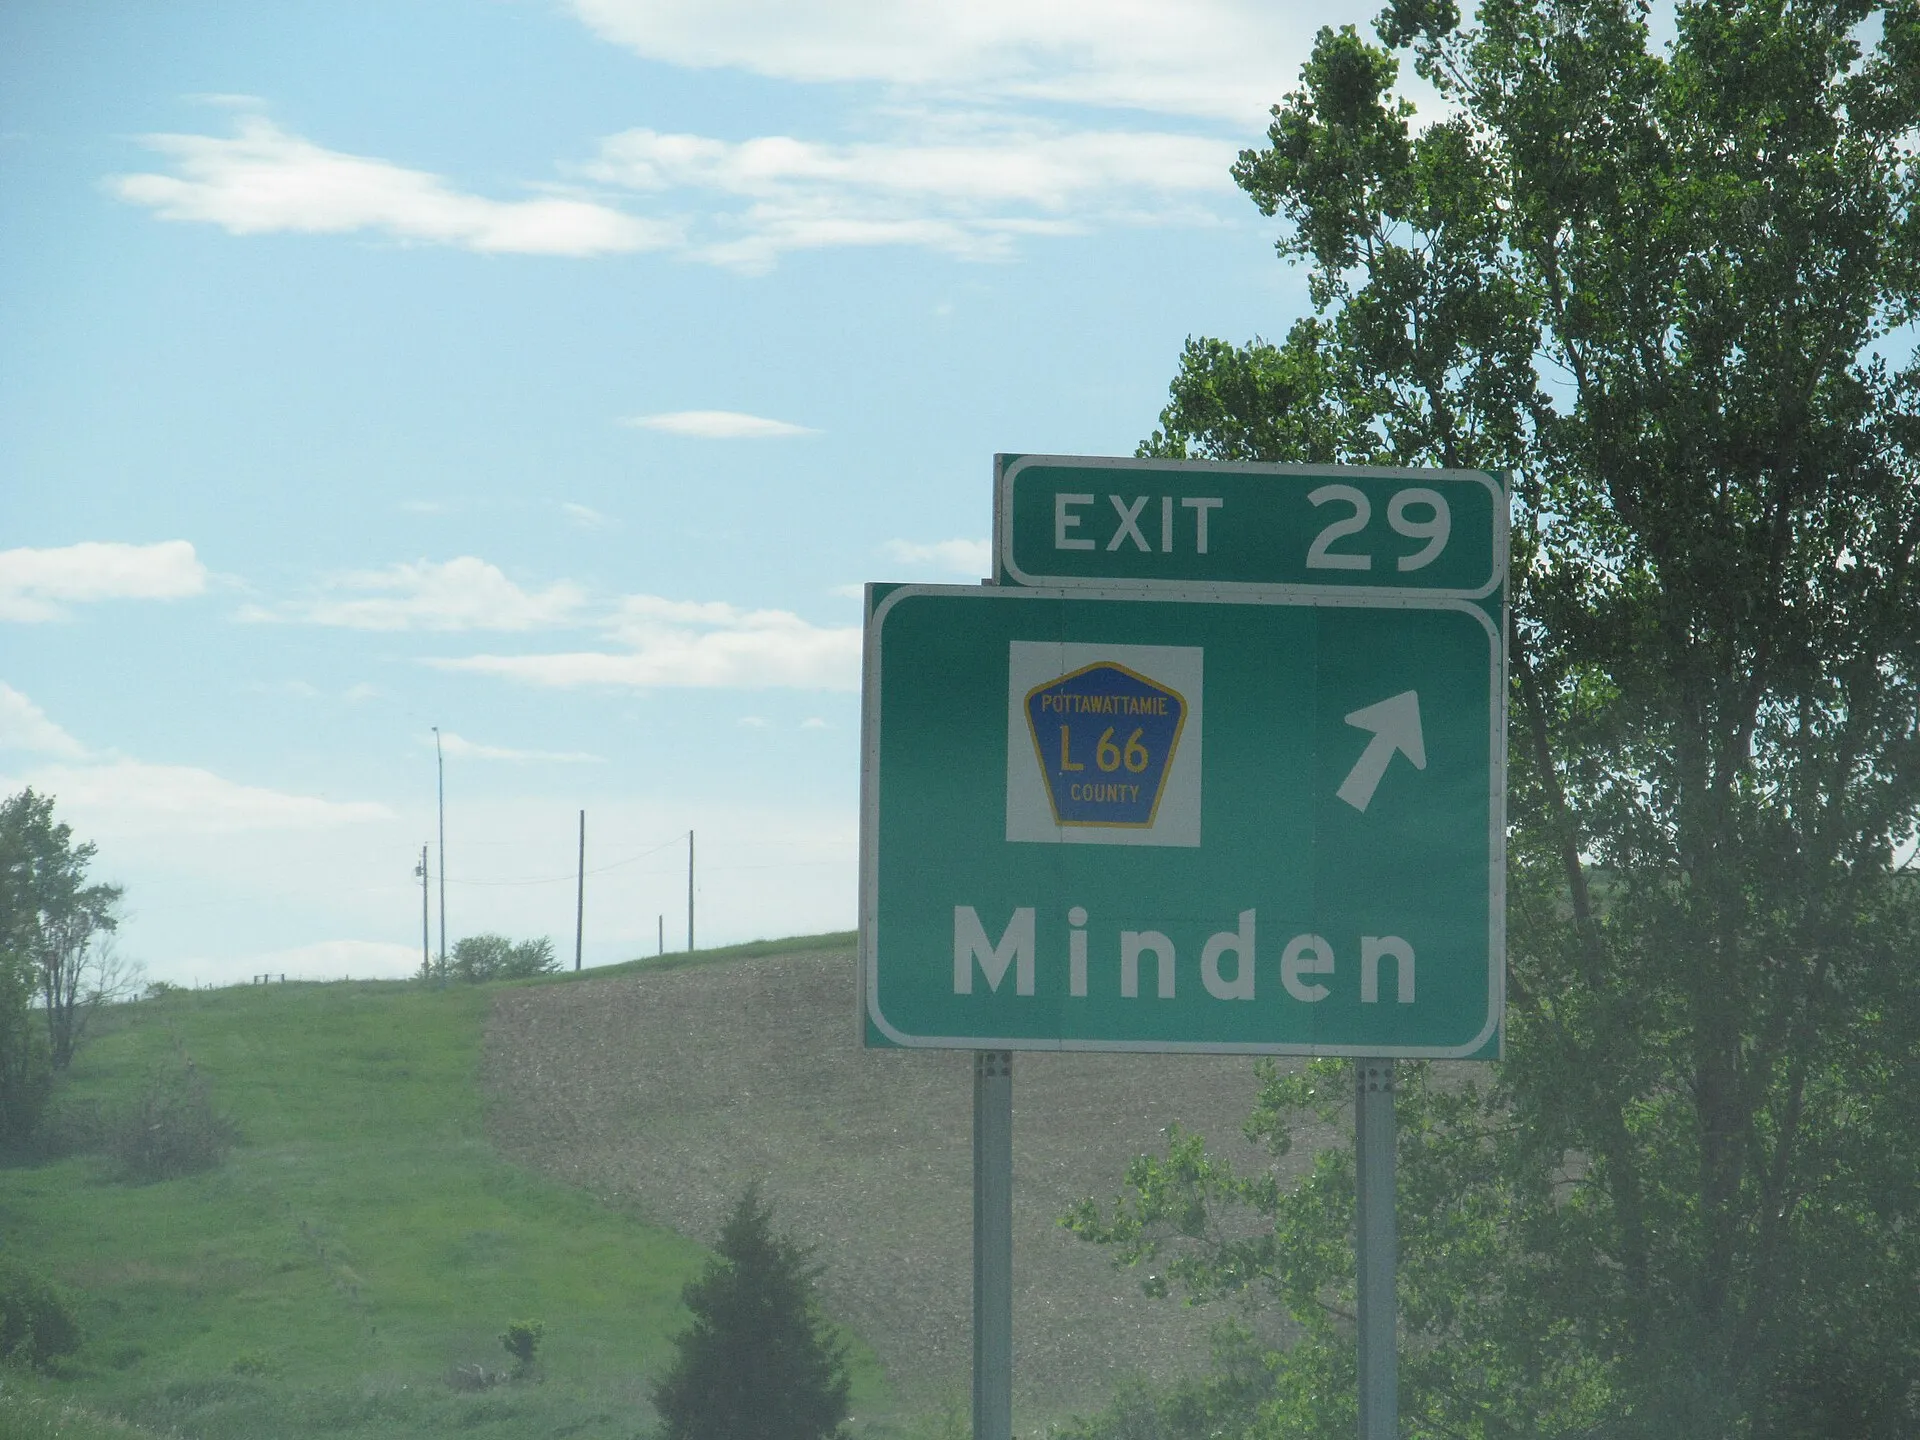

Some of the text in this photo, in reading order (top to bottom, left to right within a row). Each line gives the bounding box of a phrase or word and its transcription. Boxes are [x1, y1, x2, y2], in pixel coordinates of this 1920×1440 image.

[1054, 484, 1452, 572] EXIT 29
[1041, 694, 1168, 716] POTTAWATTAMIE
[1060, 725, 1148, 773] L 66
[1071, 784, 1139, 802] COUNTY
[953, 905, 1416, 1004] Minden
